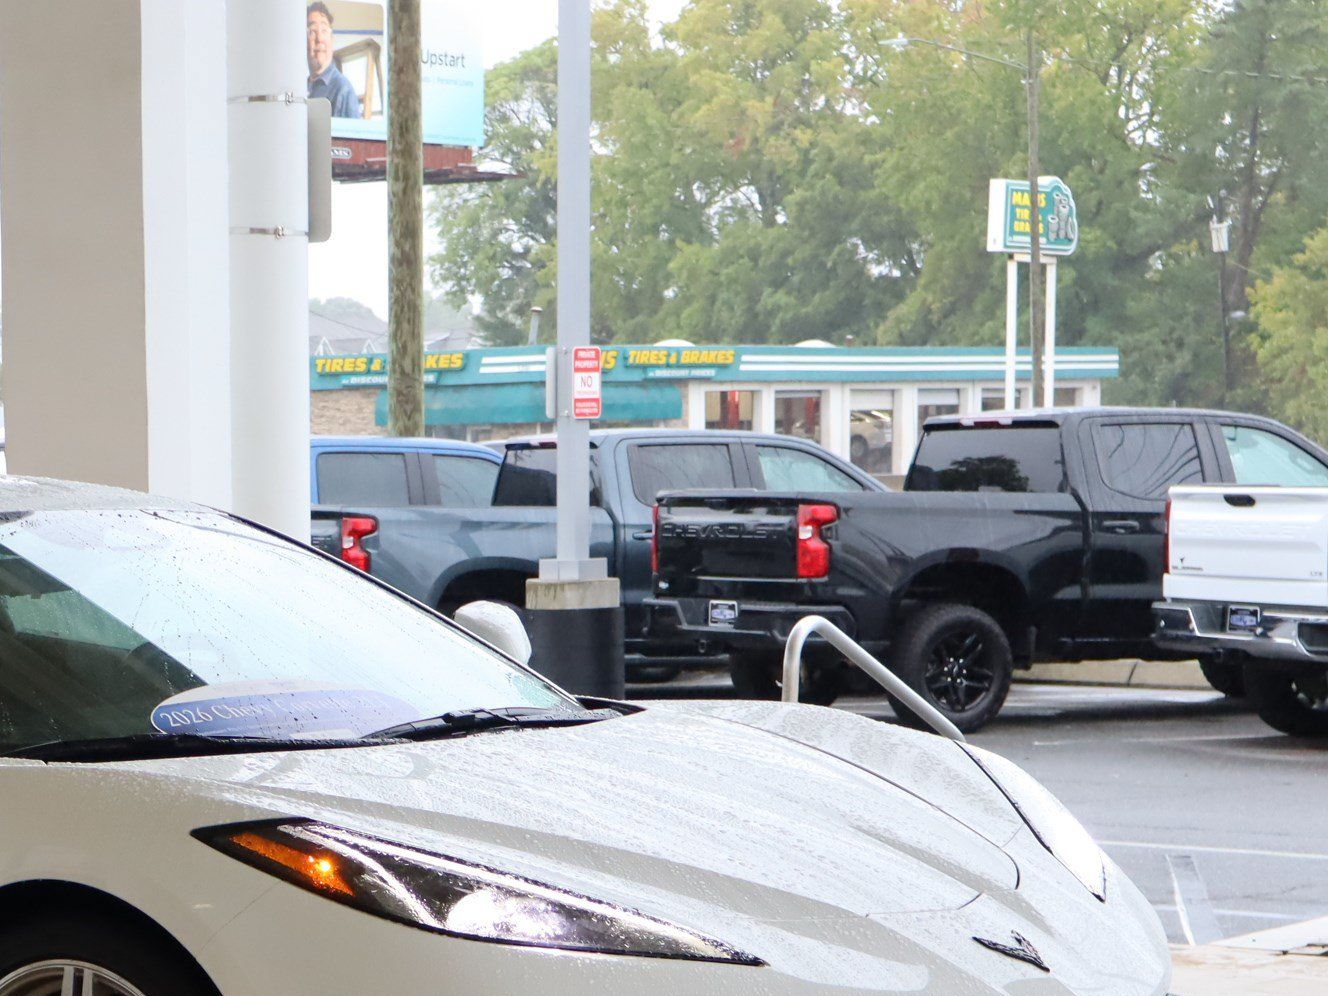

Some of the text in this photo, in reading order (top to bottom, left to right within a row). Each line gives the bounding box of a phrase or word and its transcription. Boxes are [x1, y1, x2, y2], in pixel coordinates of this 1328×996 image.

[421, 50, 466, 68] Upstart
[628, 350, 668, 364] TIRES
[681, 350, 735, 364] BRAKES
[316, 358, 367, 373] TIRES
[371, 359, 383, 371] &
[580, 375, 593, 388] NO
[662, 524, 785, 538] CHEVROLET
[159, 706, 213, 728] 2026
